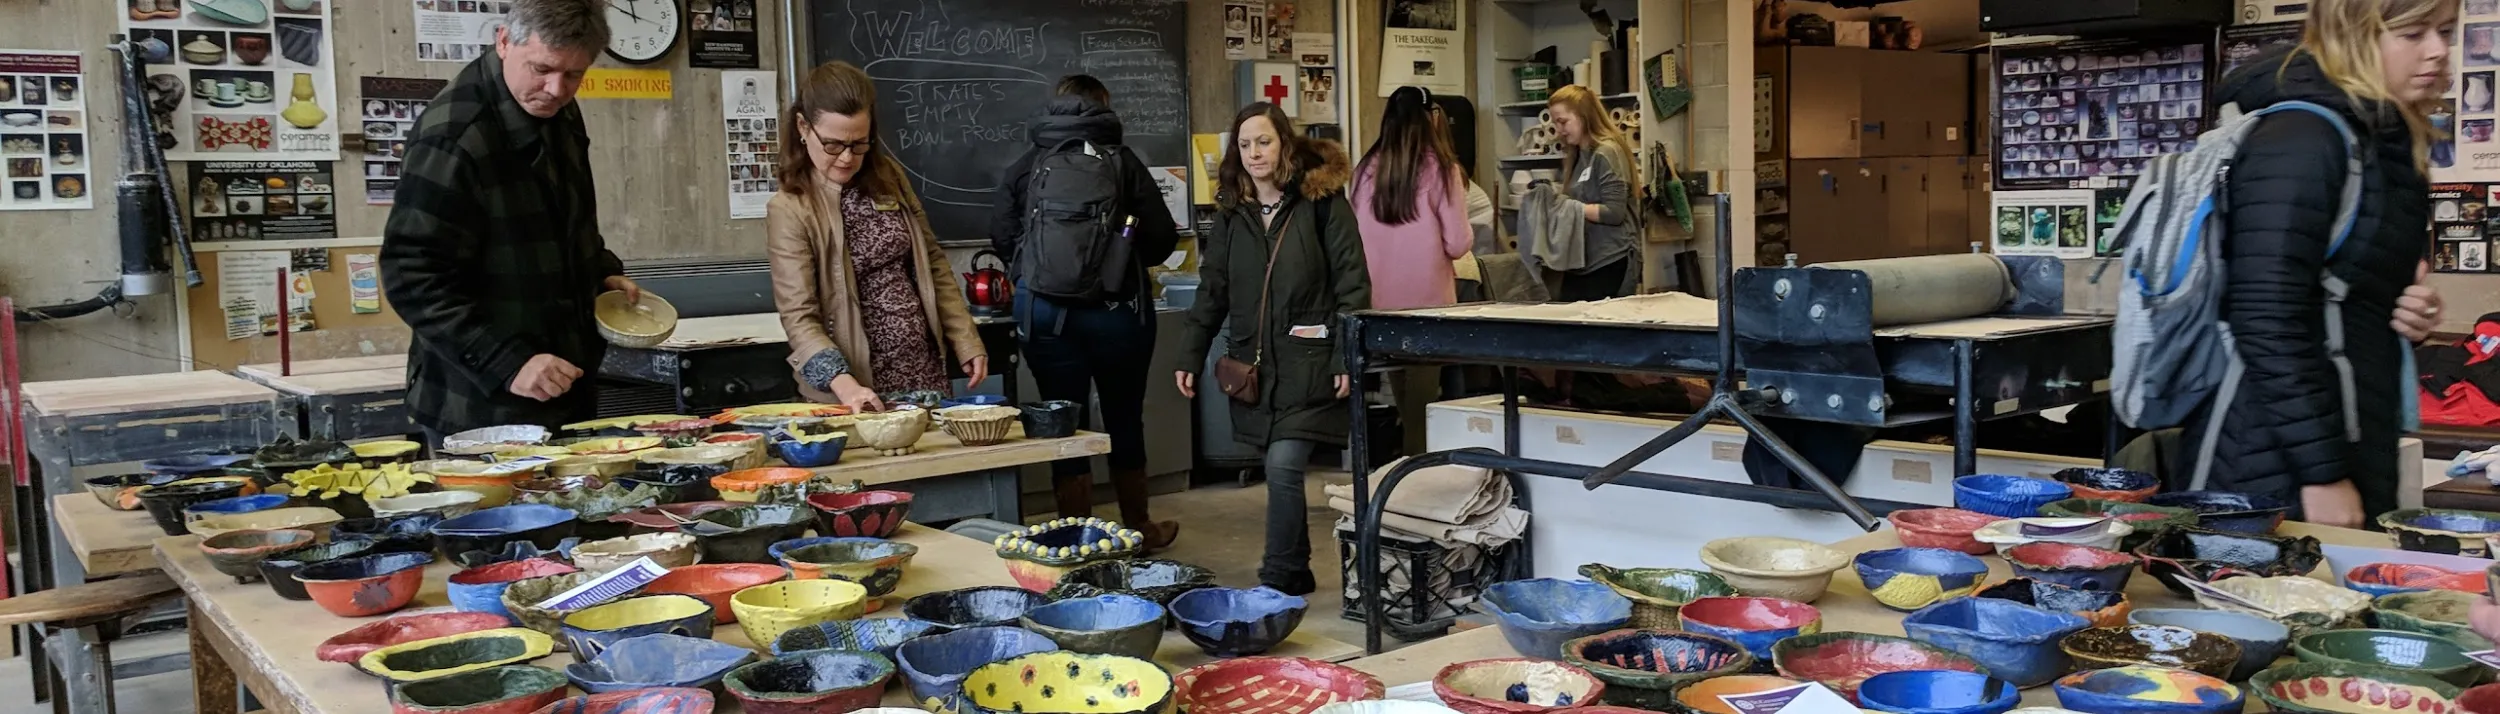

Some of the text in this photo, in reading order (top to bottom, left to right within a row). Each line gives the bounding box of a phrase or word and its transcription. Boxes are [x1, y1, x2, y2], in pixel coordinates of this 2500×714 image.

[660, 11, 667, 20] 3
[863, 10, 1035, 59] WELCOME
[1393, 34, 1409, 44] THE
[619, 39, 626, 47] 7
[648, 37, 655, 46] 5
[634, 42, 641, 51] 6
[604, 77, 671, 93] SMOKING
[932, 81, 1006, 101] KATE'S
[735, 105, 766, 114] AGAIN
[905, 102, 984, 125] EMPTY
[280, 133, 331, 141] ceramics
[896, 121, 1029, 151] BOWL PROJECT
